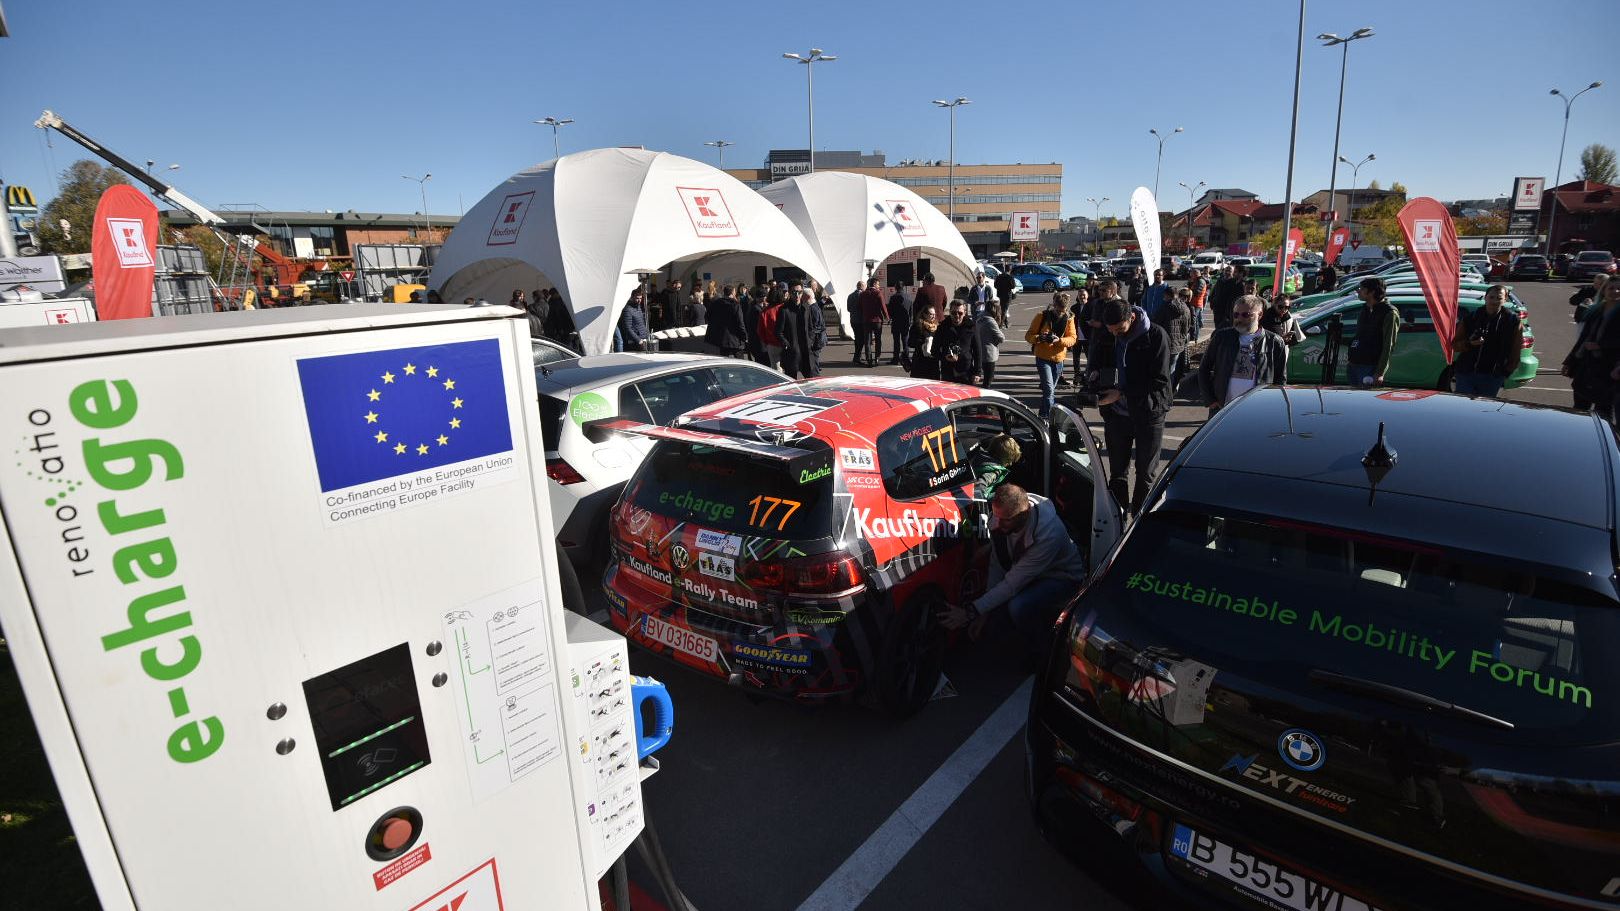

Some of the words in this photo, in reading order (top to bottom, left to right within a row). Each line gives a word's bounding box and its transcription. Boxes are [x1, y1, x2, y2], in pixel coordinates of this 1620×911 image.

[697, 220, 732, 230] Kaufland
[921, 424, 959, 473] 177
[326, 482, 397, 507] Co-financed
[400, 478, 413, 492] by
[416, 474, 433, 486] the
[435, 464, 484, 482] European
[486, 456, 513, 469] Union
[799, 463, 832, 485] Electric
[932, 473, 950, 486] Sorin
[330, 498, 396, 522] Connecting
[399, 488, 438, 505] Europe
[440, 479, 476, 495] Facility
[658, 490, 735, 521] e-charge
[749, 495, 801, 531] 177
[853, 507, 960, 539] Kaufland
[69, 379, 225, 764] e-charge
[629, 555, 672, 584] Kaufland
[673, 577, 716, 601] e-Rally
[719, 588, 759, 610] Team
[646, 617, 665, 637] BV
[667, 628, 714, 659] 031665
[735, 644, 808, 664] GOODYEAR
[1125, 571, 1299, 626] #Sustainable
[1308, 609, 1457, 671] Mobility
[1469, 649, 1593, 709] Forum
[1306, 784, 1357, 805] ENERGY
[1173, 839, 1188, 854] RO
[1191, 830, 1217, 864] B
[1229, 848, 1295, 899] 555
